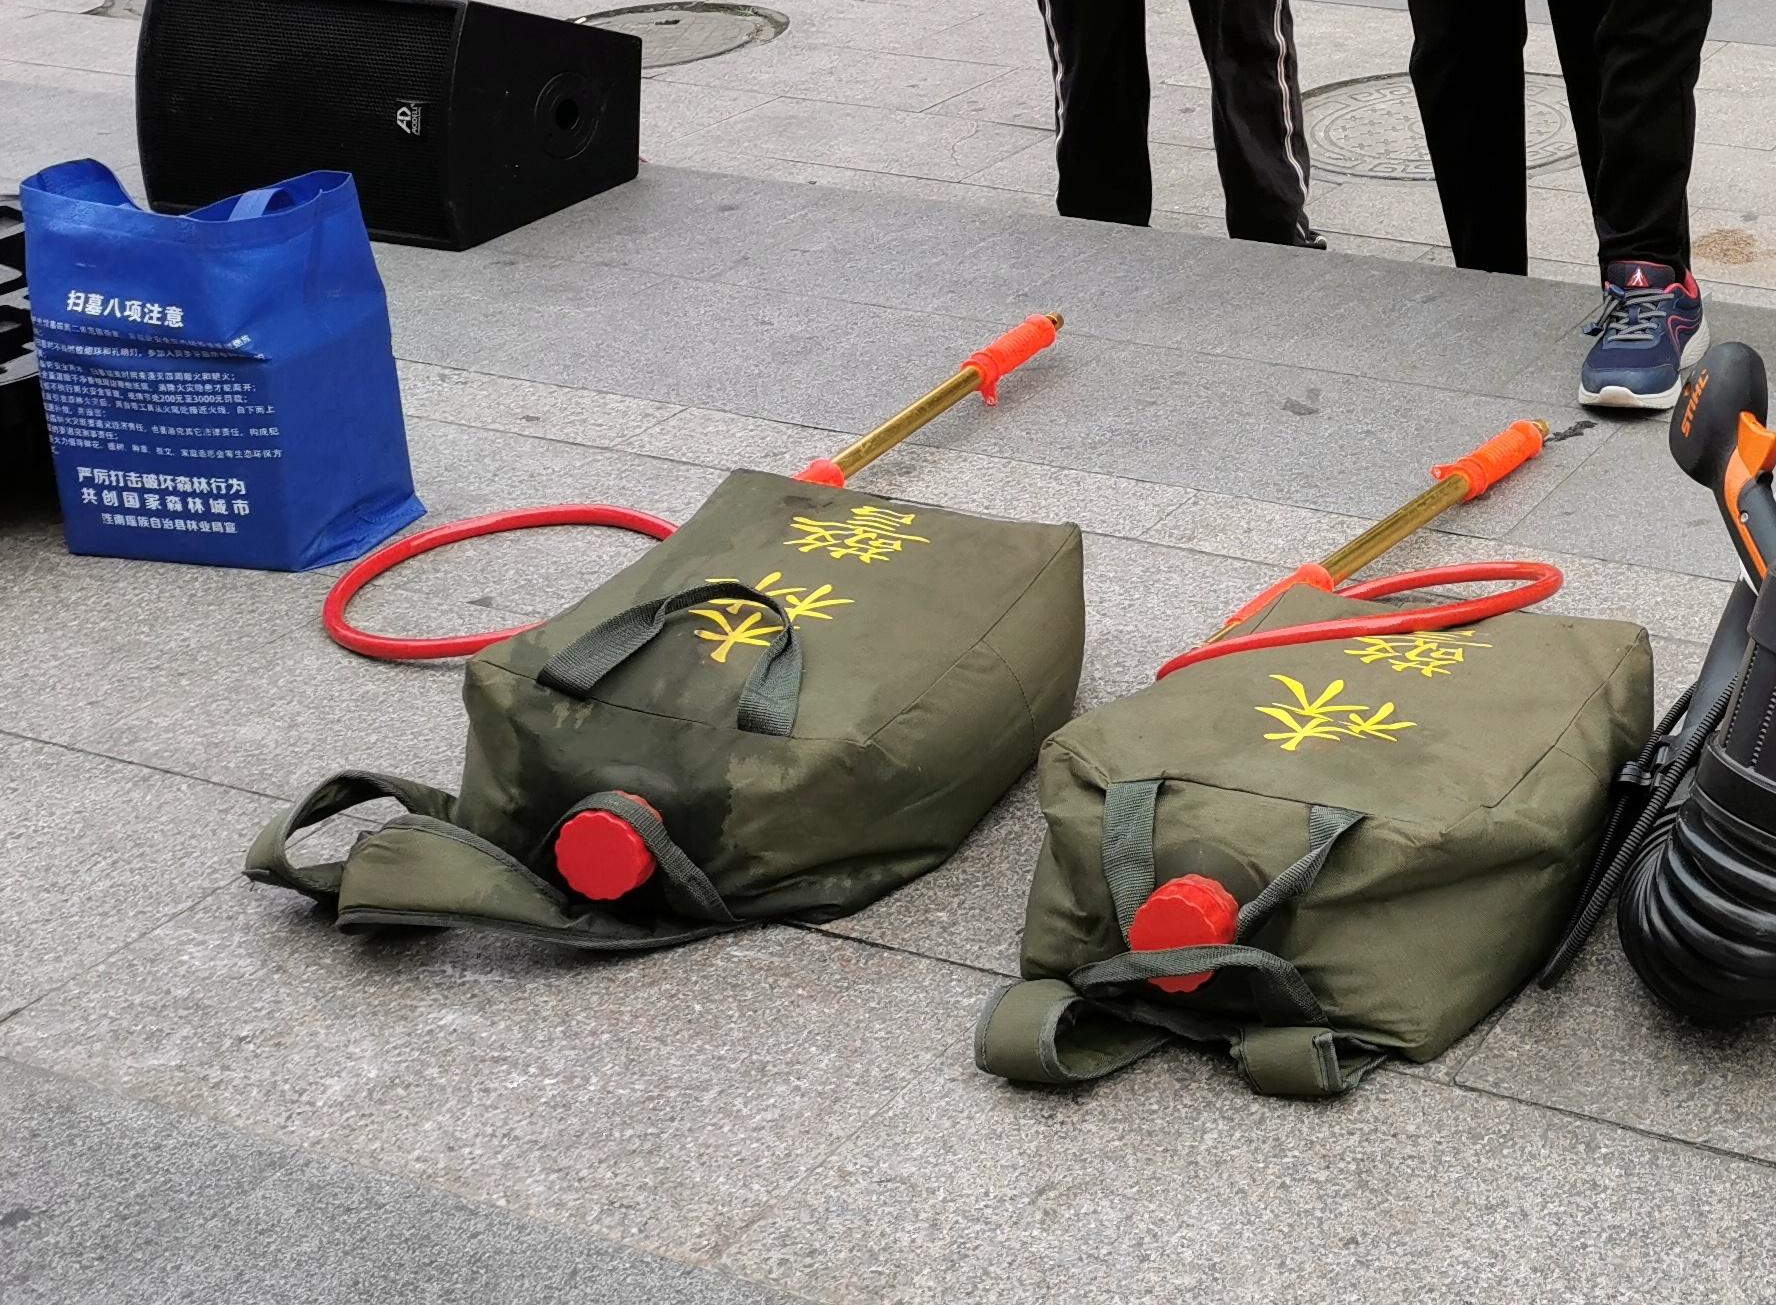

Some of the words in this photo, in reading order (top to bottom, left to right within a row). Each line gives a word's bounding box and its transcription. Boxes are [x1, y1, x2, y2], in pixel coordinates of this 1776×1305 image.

[67, 289, 185, 329] 扫墓八项注意
[1681, 372, 1709, 438] STIHL
[76, 466, 247, 495] 严厉打击破坏森林行为
[80, 487, 250, 516] 共创国家森林城市
